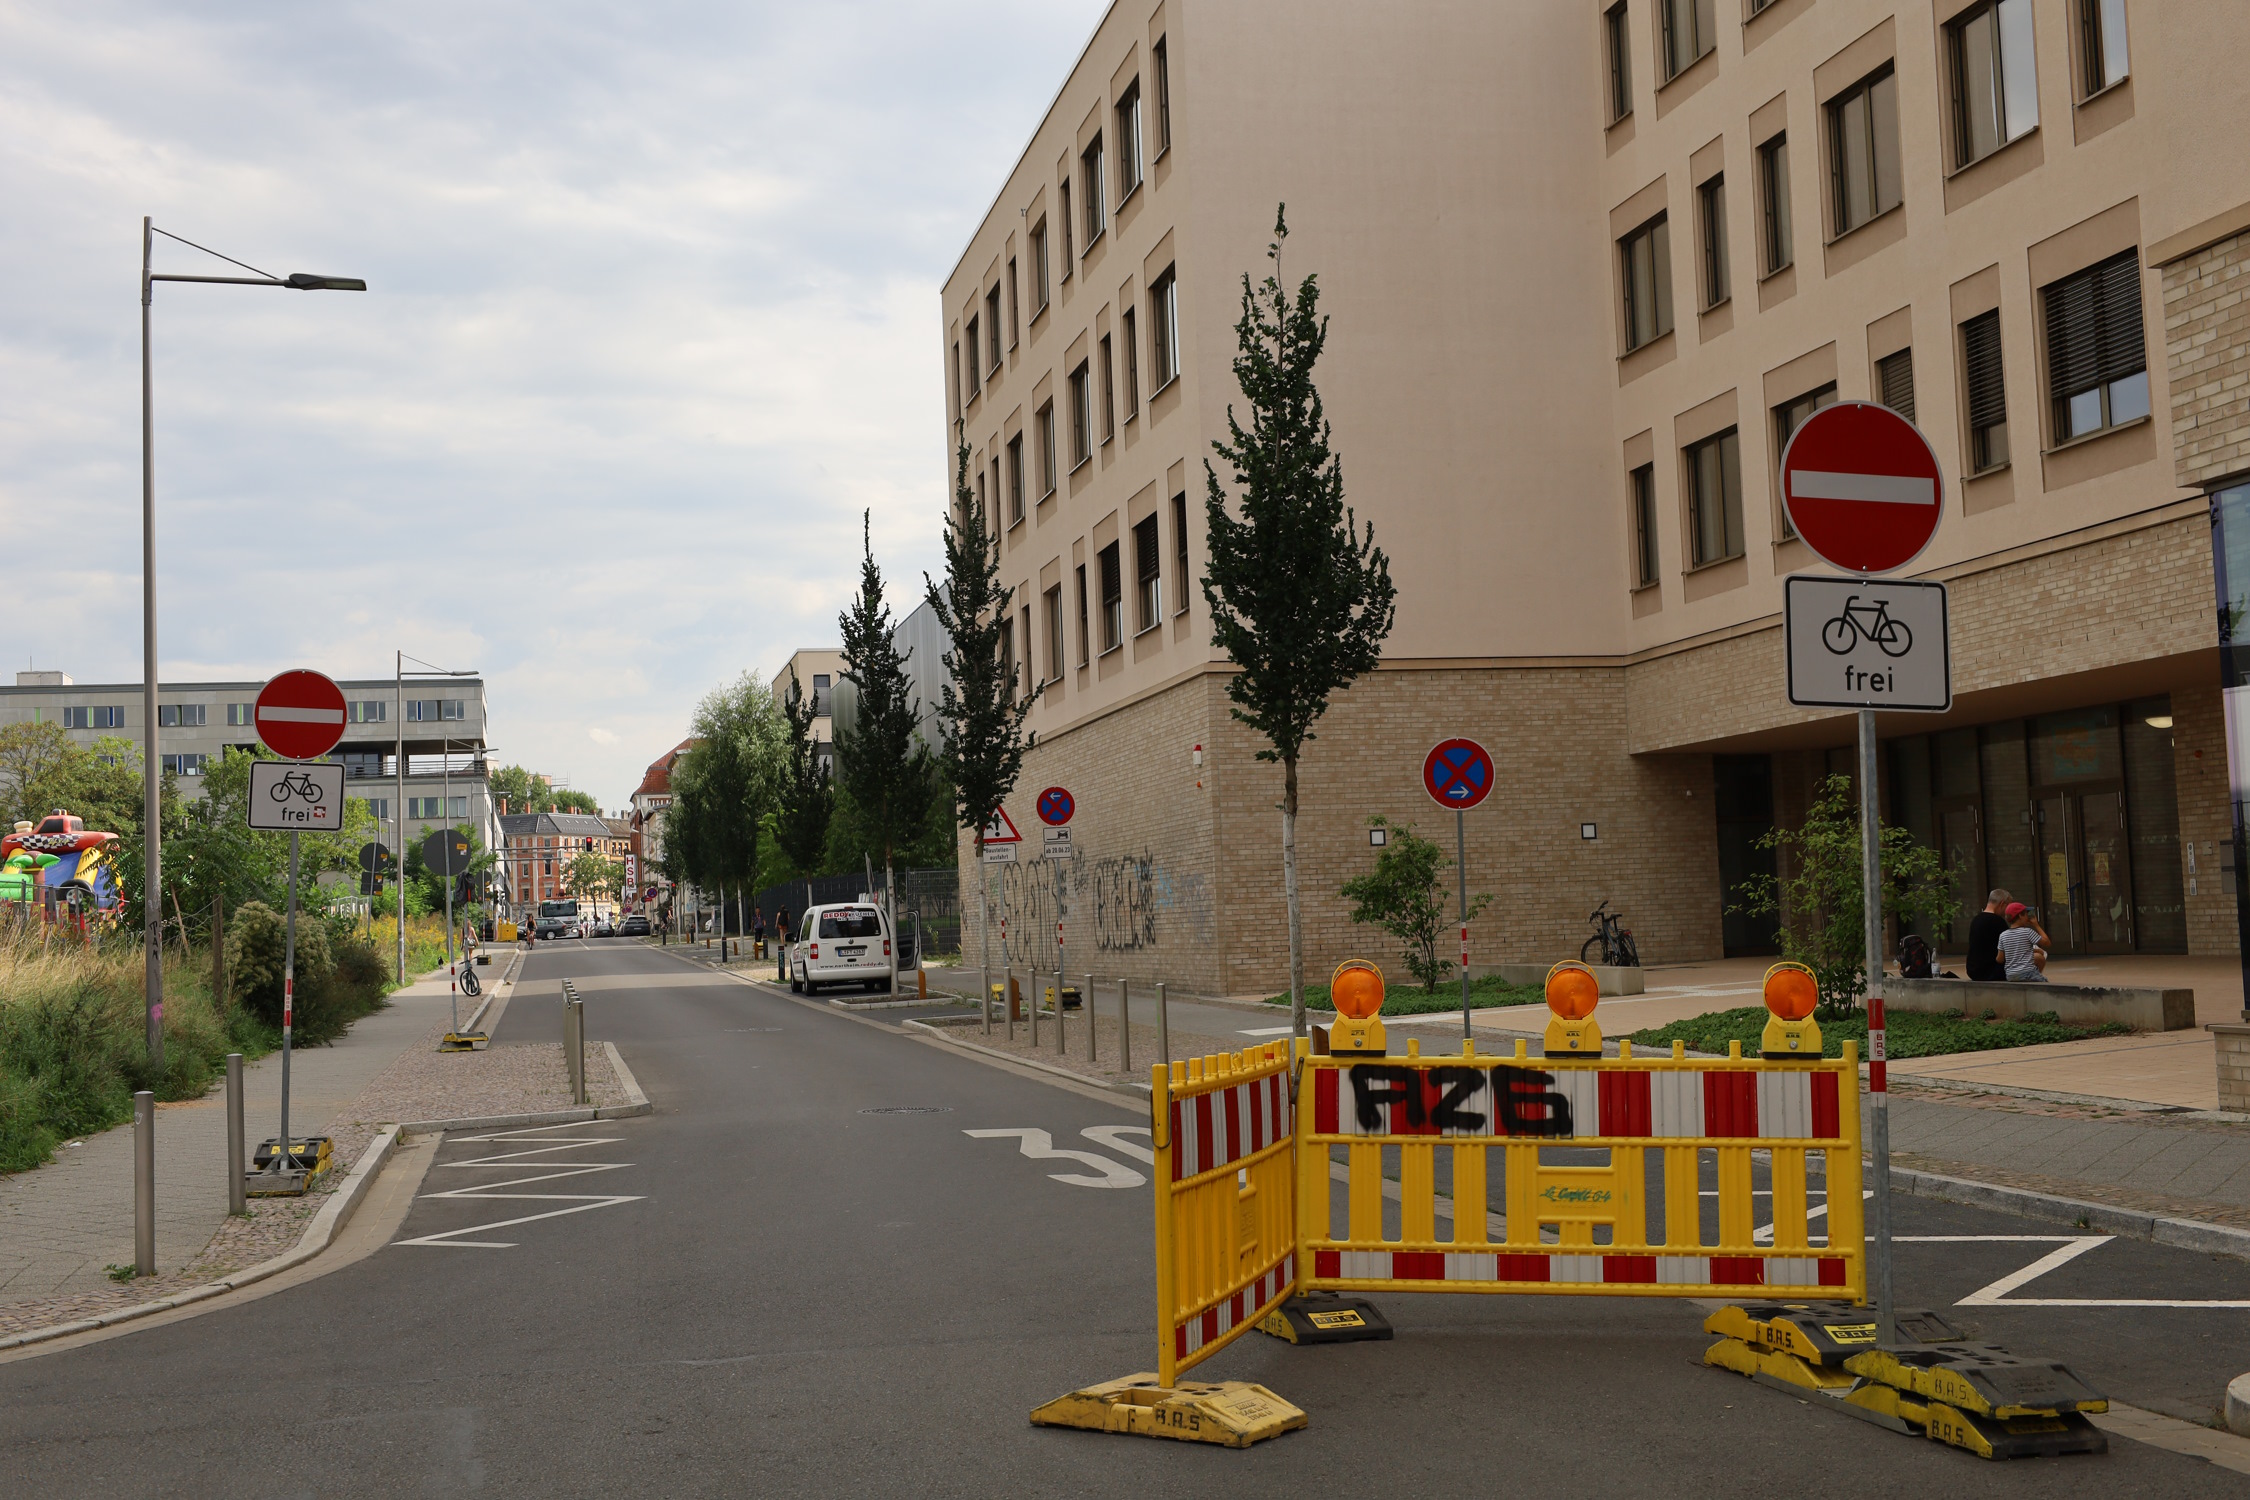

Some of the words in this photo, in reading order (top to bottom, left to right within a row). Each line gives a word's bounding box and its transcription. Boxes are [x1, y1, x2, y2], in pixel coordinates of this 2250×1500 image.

[1845, 664, 1896, 692] frei
[282, 807, 310, 822] frei
[824, 911, 849, 919] REDDY
